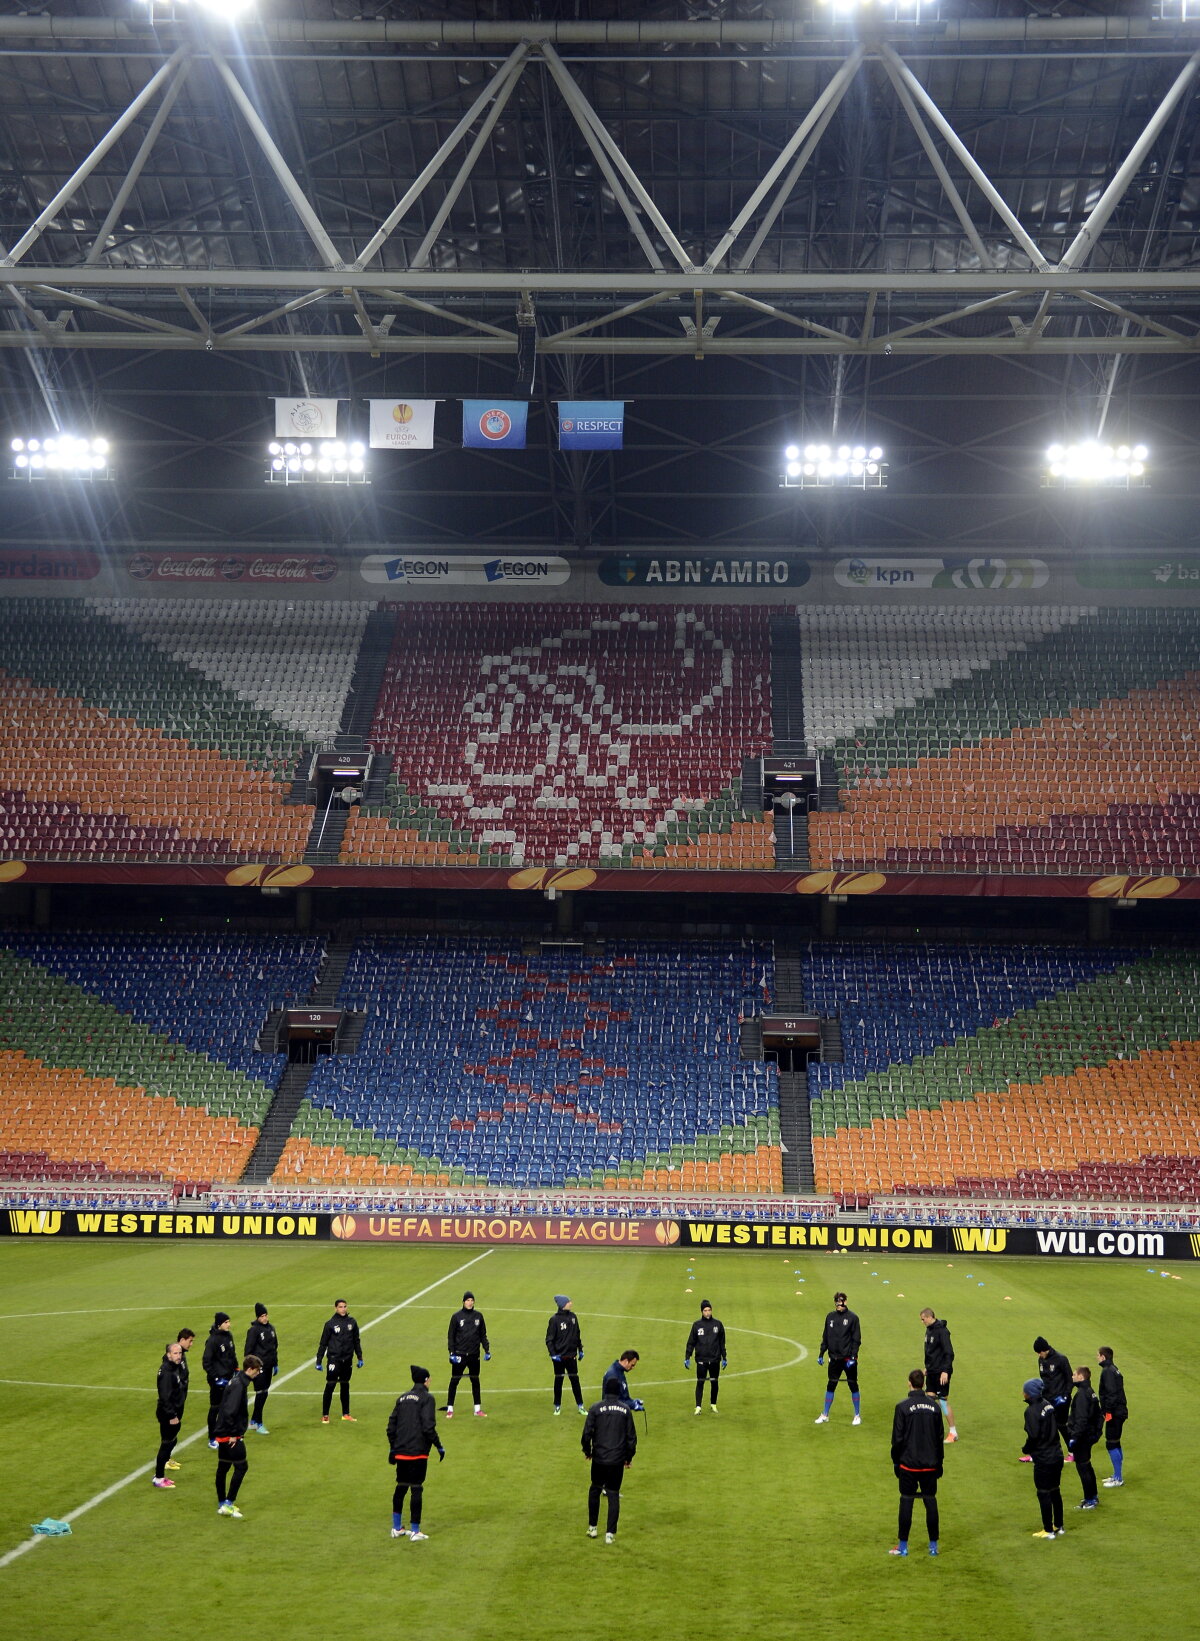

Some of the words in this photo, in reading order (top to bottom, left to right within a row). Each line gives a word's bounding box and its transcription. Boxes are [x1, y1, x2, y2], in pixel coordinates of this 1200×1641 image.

[577, 421, 623, 431] RESPECT
[386, 433, 418, 441] EUROPA
[393, 558, 449, 575] AEGON
[493, 559, 548, 576] AEGON
[876, 566, 915, 585] kpn
[76, 1213, 215, 1234] WESTERN
[222, 1215, 317, 1236] UNION
[369, 1217, 433, 1237] UEFA
[440, 1218, 537, 1239] EUROPA
[545, 1220, 640, 1241] LEAGUE
[688, 1223, 829, 1246] WESTERN
[836, 1227, 933, 1249] UNION
[1036, 1230, 1165, 1257] wu.com
